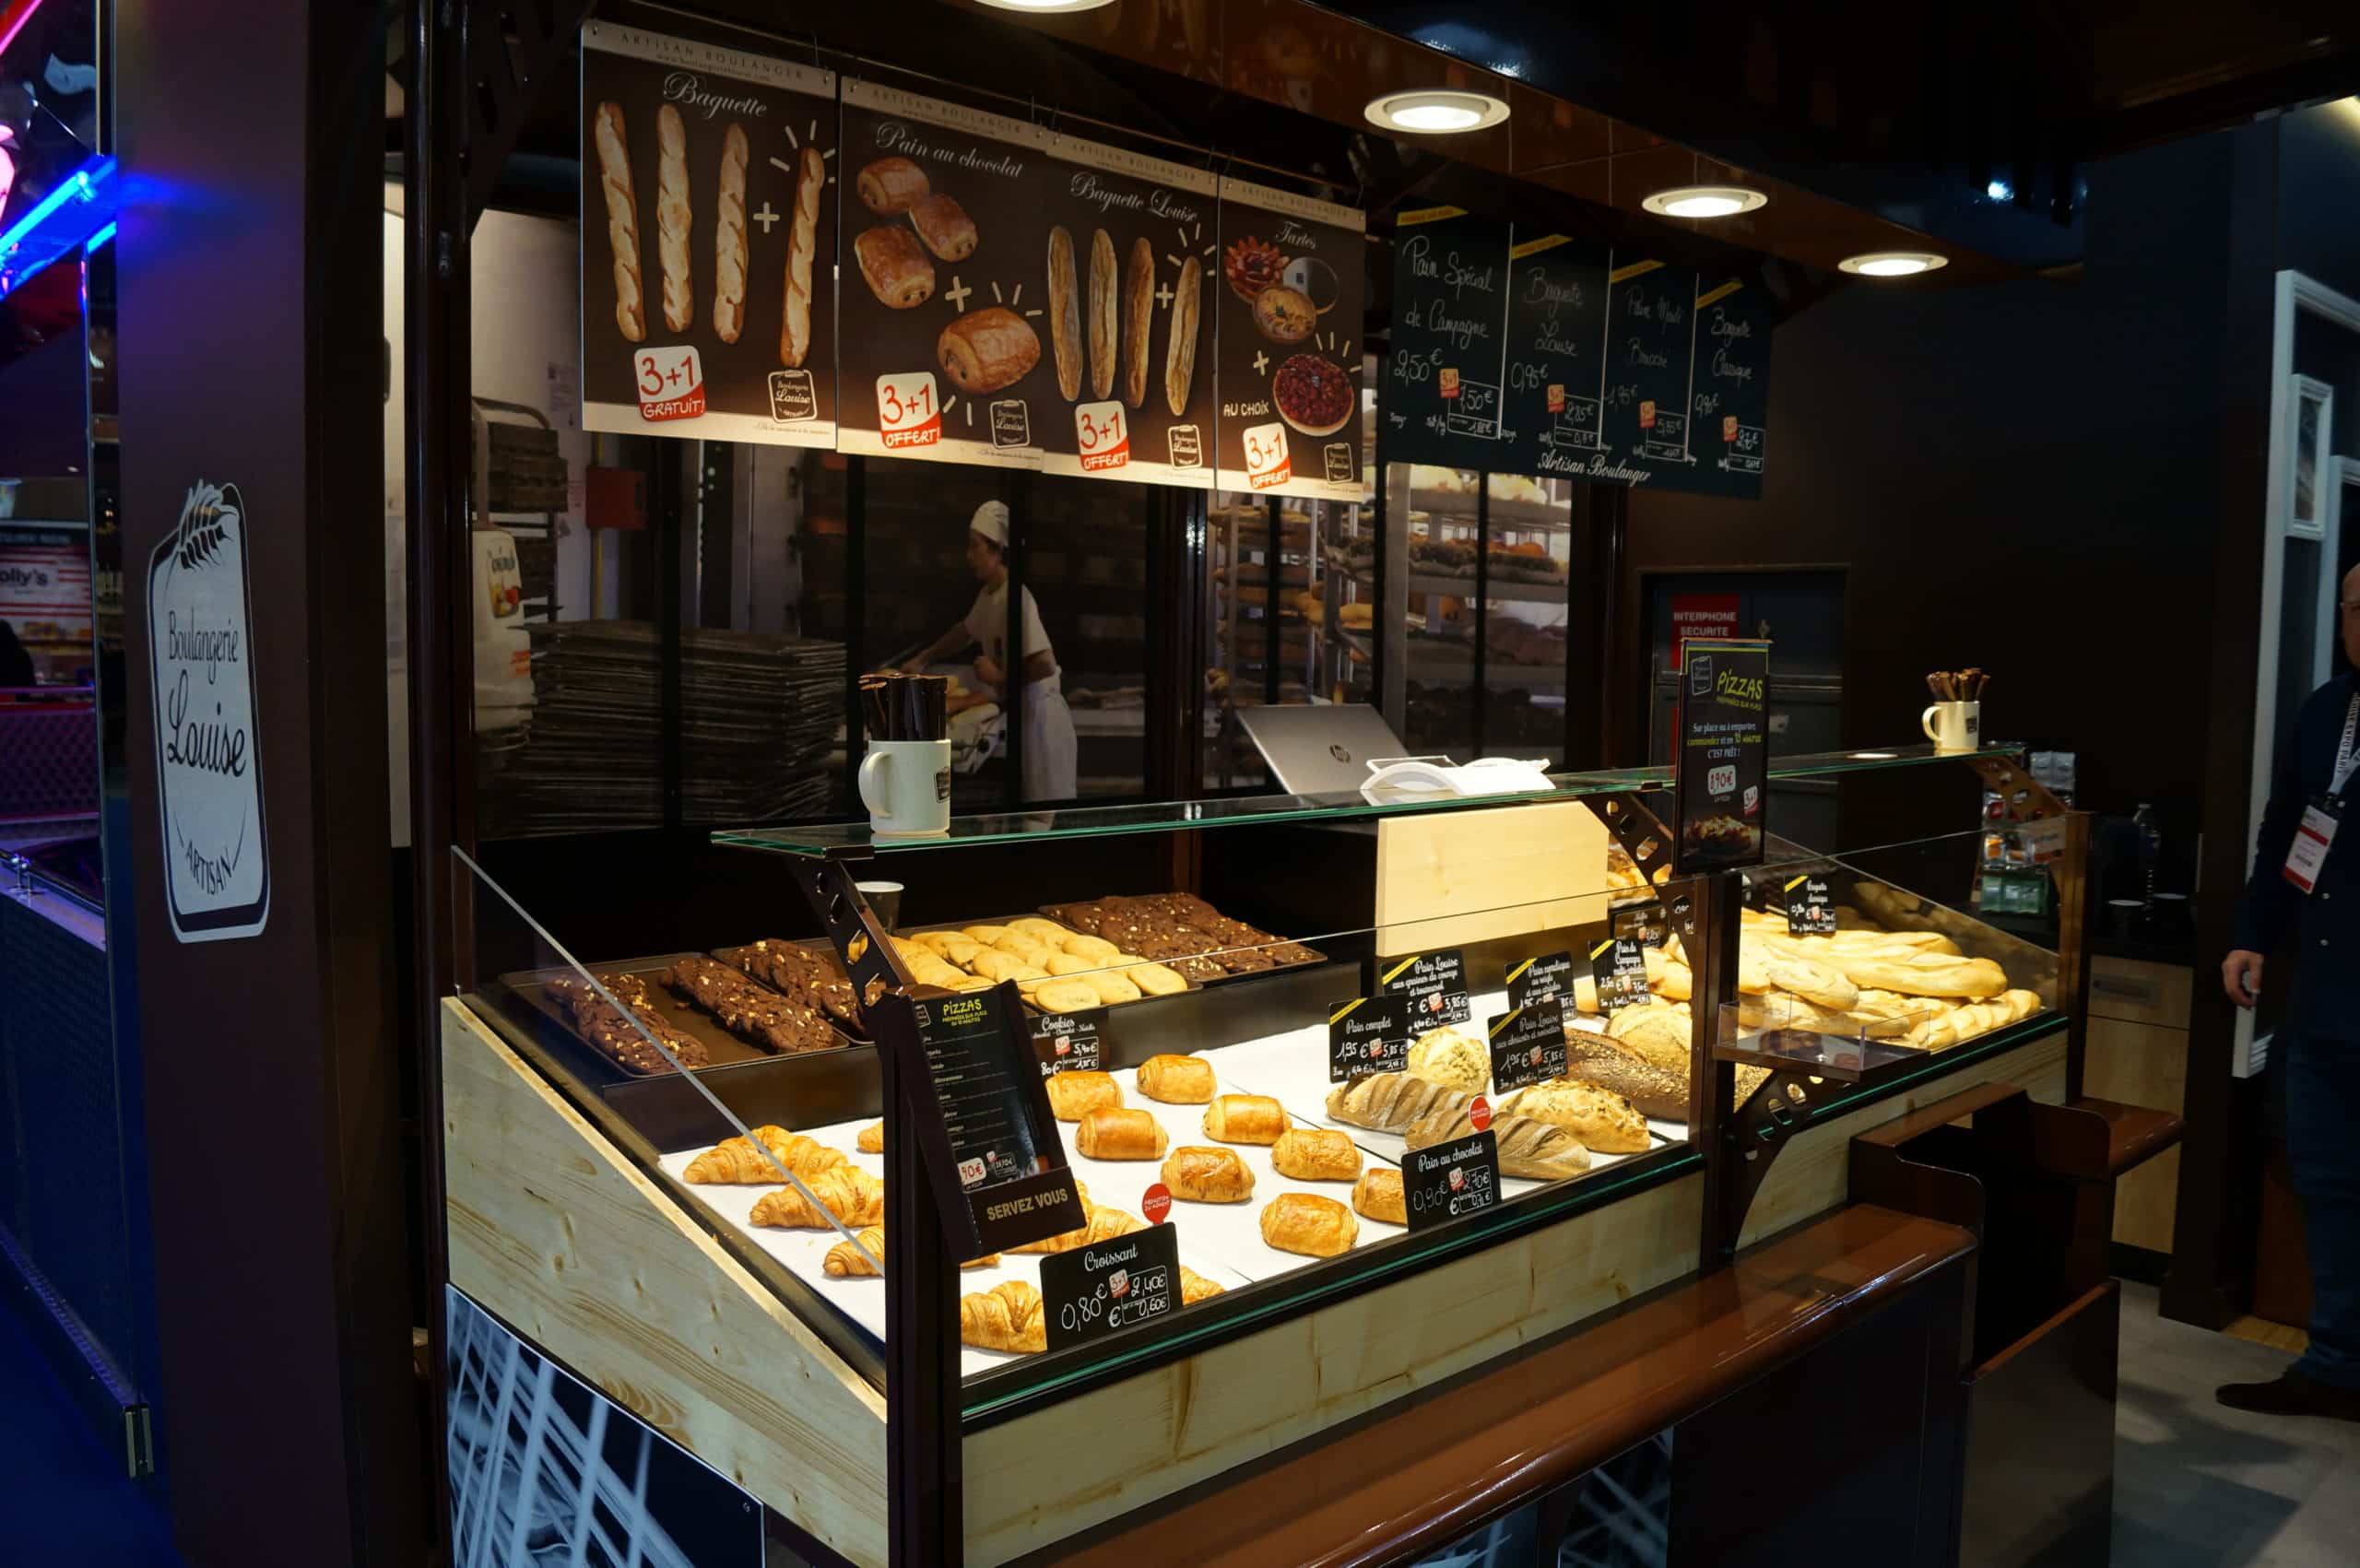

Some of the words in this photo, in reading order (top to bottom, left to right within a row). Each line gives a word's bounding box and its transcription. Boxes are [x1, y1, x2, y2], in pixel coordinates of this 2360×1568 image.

[621, 30, 694, 55] ARTISAN
[704, 49, 804, 80] BOULANGER
[663, 71, 767, 120] Baguette
[876, 121, 928, 157] Pain
[933, 148, 955, 163] au
[958, 147, 1023, 178] chocolat
[1069, 171, 1144, 211] Baguette
[1146, 188, 1200, 223] Louise
[1275, 220, 1320, 251] Tartes
[1402, 235, 1439, 277] Pain
[1405, 299, 1421, 327] de
[1429, 299, 1490, 350] Campagne
[639, 355, 695, 396] 3+1
[642, 396, 706, 419] GRATUIT!
[775, 389, 811, 406] Louise
[881, 383, 932, 424] 3+1
[1223, 403, 1238, 418] AU
[1240, 399, 1270, 417] CHOIX
[885, 427, 941, 448] OFFERT!
[1079, 411, 1120, 450] 3+1
[1248, 432, 1283, 469] 3+1
[1537, 450, 1586, 475] Artisan
[1587, 453, 1653, 488] Boulanger
[1673, 611, 1738, 622] INTERPHONE
[168, 607, 239, 685] Boulangerie
[1717, 668, 1764, 701] PIZZAS
[167, 669, 247, 778] Louise
[185, 843, 232, 896] ARTISAN
[1414, 960, 1434, 974] Pain
[1434, 955, 1459, 972] Louise
[942, 998, 982, 1016] PIZZAS
[1042, 1016, 1075, 1032] Cookies
[1519, 1017, 1536, 1032] Pain
[1539, 1012, 1559, 1027] Louise
[1346, 1020, 1365, 1034] Pain
[1365, 1016, 1392, 1032] complet
[1419, 1154, 1438, 1173] Pain
[1440, 1156, 1450, 1166] au
[1452, 1142, 1483, 1162] chocolat
[986, 1197, 1034, 1222] SERVEZ
[1035, 1187, 1068, 1210] VOUS
[1084, 1243, 1139, 1272] Croissant
